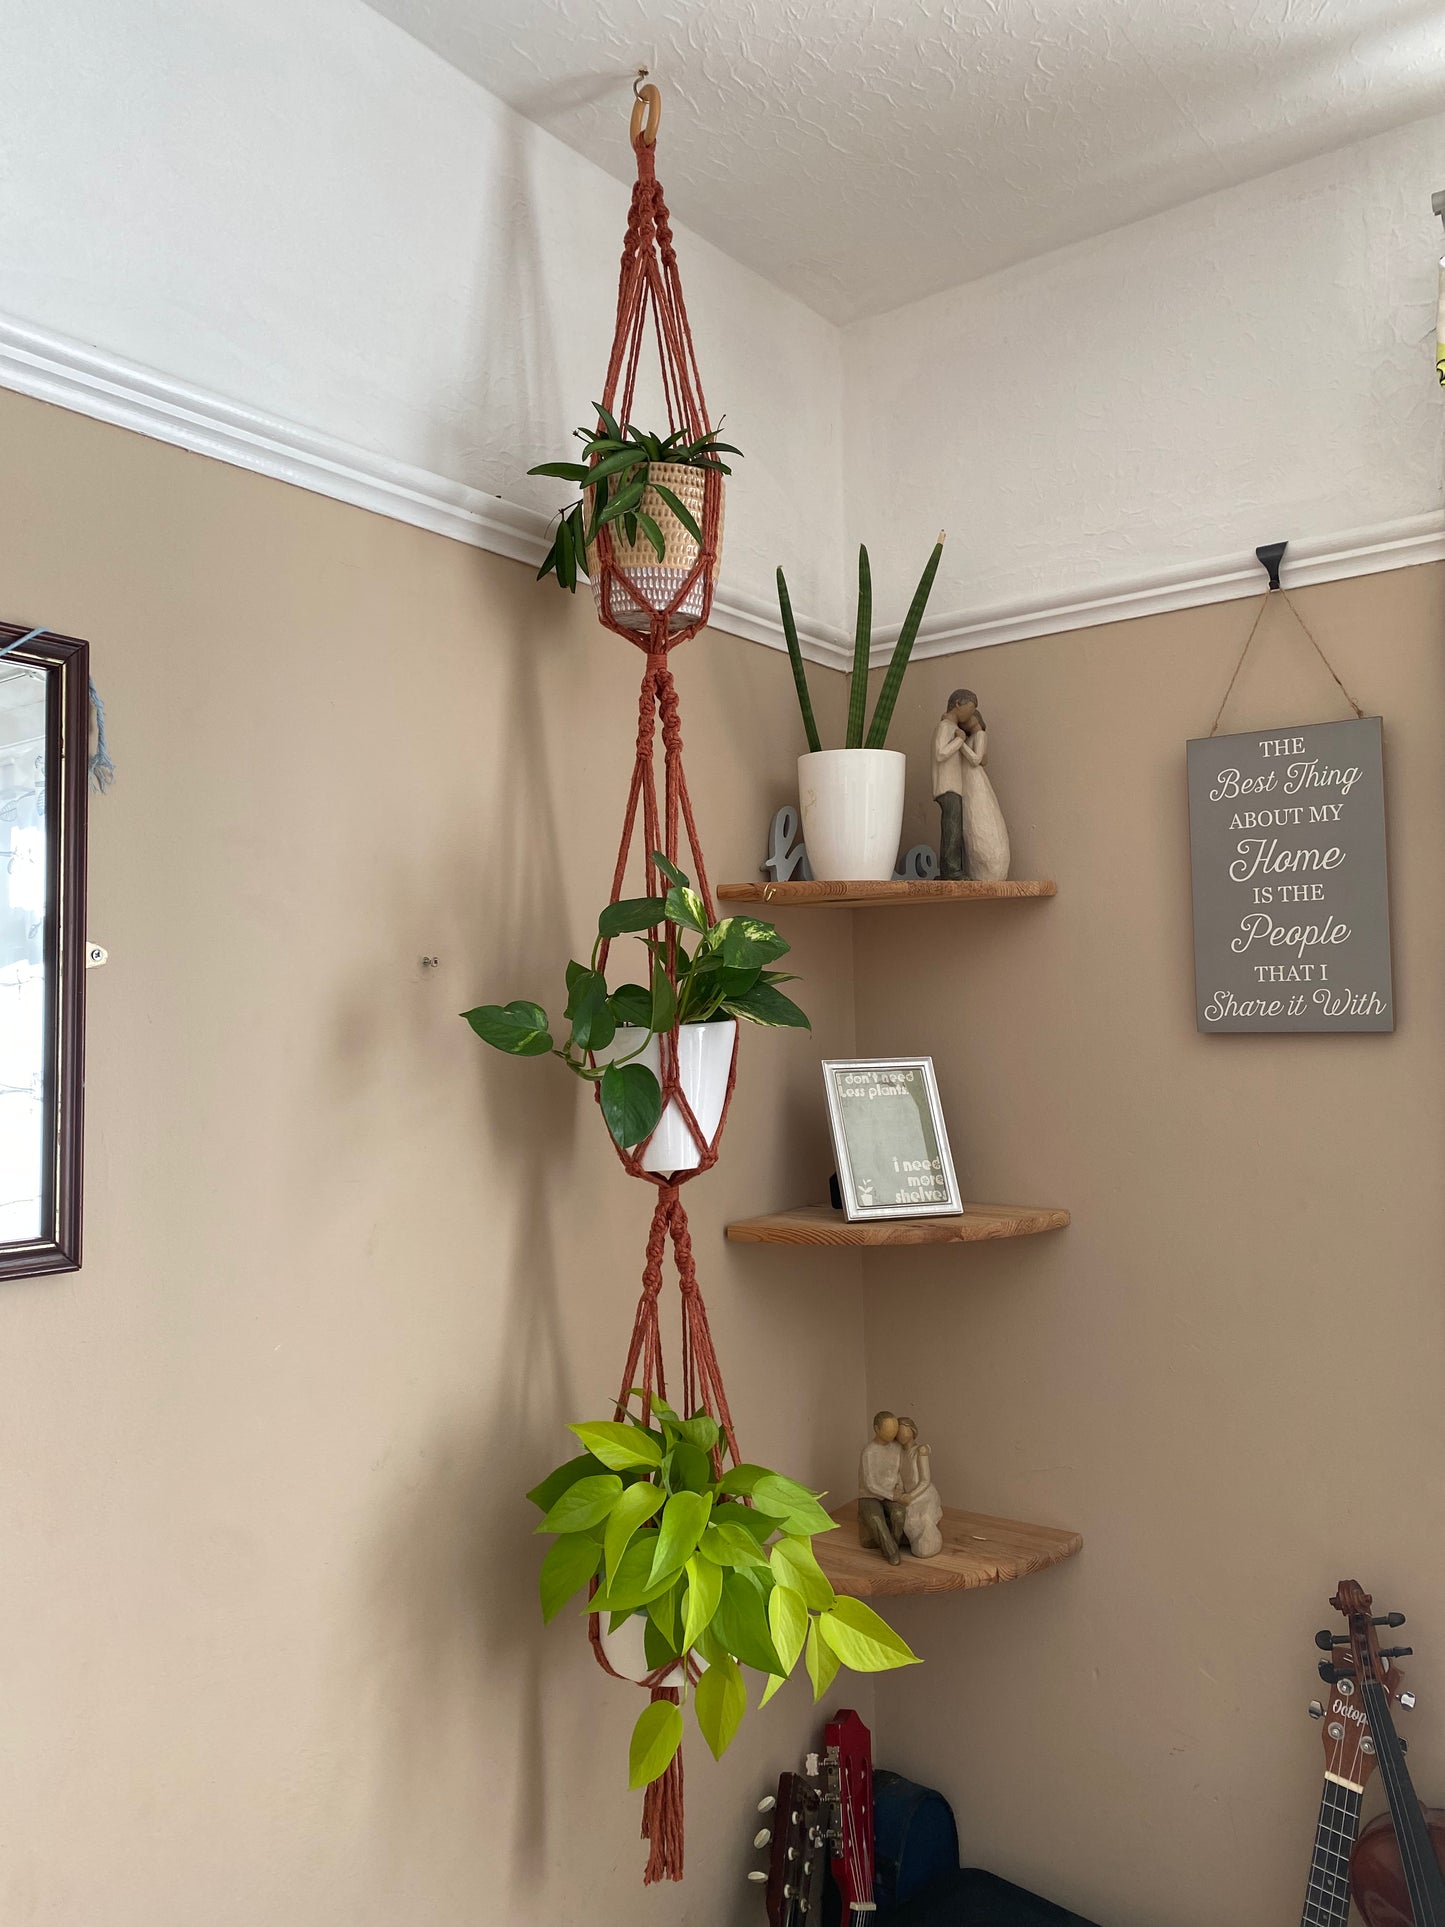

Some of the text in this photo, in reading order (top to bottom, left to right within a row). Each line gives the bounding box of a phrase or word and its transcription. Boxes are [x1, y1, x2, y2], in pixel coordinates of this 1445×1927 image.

[1259, 737, 1306, 758] THE
[1209, 758, 1363, 802] Best Thing
[1228, 803, 1344, 830] ABOUT MY
[1228, 838, 1346, 882] Home
[1252, 883, 1325, 904] IS THE
[1230, 913, 1352, 959] People
[1254, 964, 1328, 983] THAT I
[1204, 988, 1387, 1022] Share it With
[845, 1072, 878, 1085] don't
[882, 1071, 914, 1083] need
[869, 1083, 910, 1100] plants.
[903, 1156, 941, 1172] need
[908, 1175, 944, 1187] more
[1333, 1699, 1369, 1728] Octop
